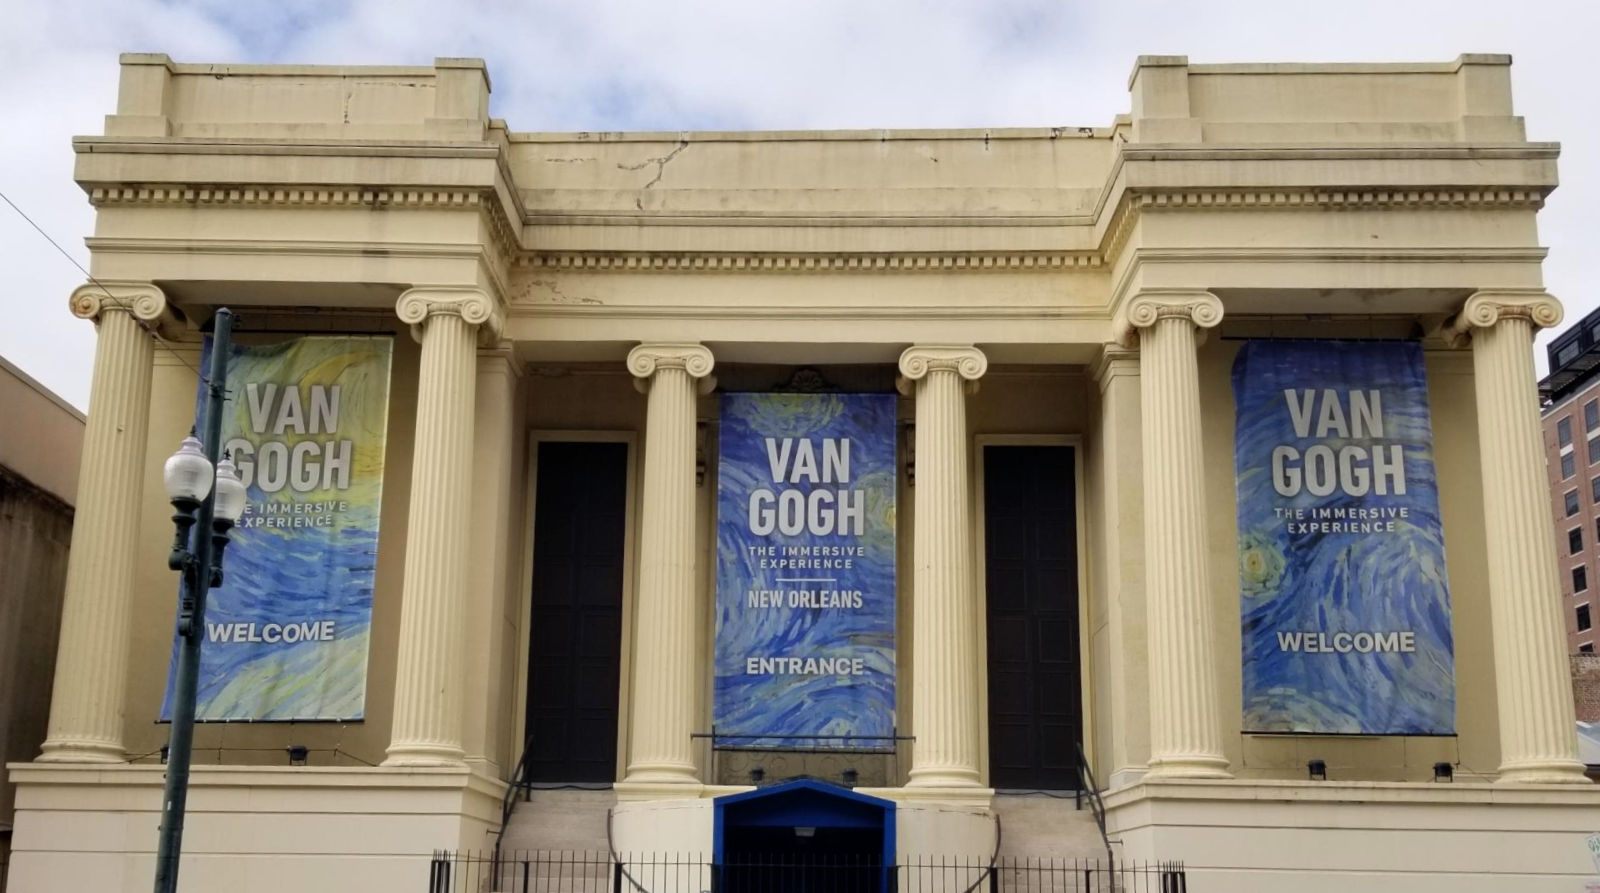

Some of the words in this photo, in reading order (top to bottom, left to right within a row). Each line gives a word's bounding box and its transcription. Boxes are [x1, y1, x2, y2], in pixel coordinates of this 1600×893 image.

[246, 383, 340, 436] VAN
[1284, 388, 1384, 438] VAN
[225, 439, 352, 492] GOGH
[765, 438, 850, 484] VAN
[1272, 445, 1406, 497] GOGH
[259, 500, 347, 514] IMMERSIVE
[749, 489, 864, 536] GOGH
[1274, 507, 1305, 520] THE
[1311, 507, 1410, 519] IMMERSIVE
[235, 514, 332, 528] EXPERIENCE
[1287, 521, 1396, 534] EXPERIENCE
[749, 546, 775, 556] THE
[782, 546, 864, 557] IMMERSIVE
[760, 559, 853, 569] EXPERIENCE
[748, 590, 782, 608] NEW
[788, 590, 863, 609] ORLEANS
[207, 620, 335, 644] WELCOME
[1277, 631, 1416, 653] WELCOME
[747, 657, 864, 675] ENTRANCE
